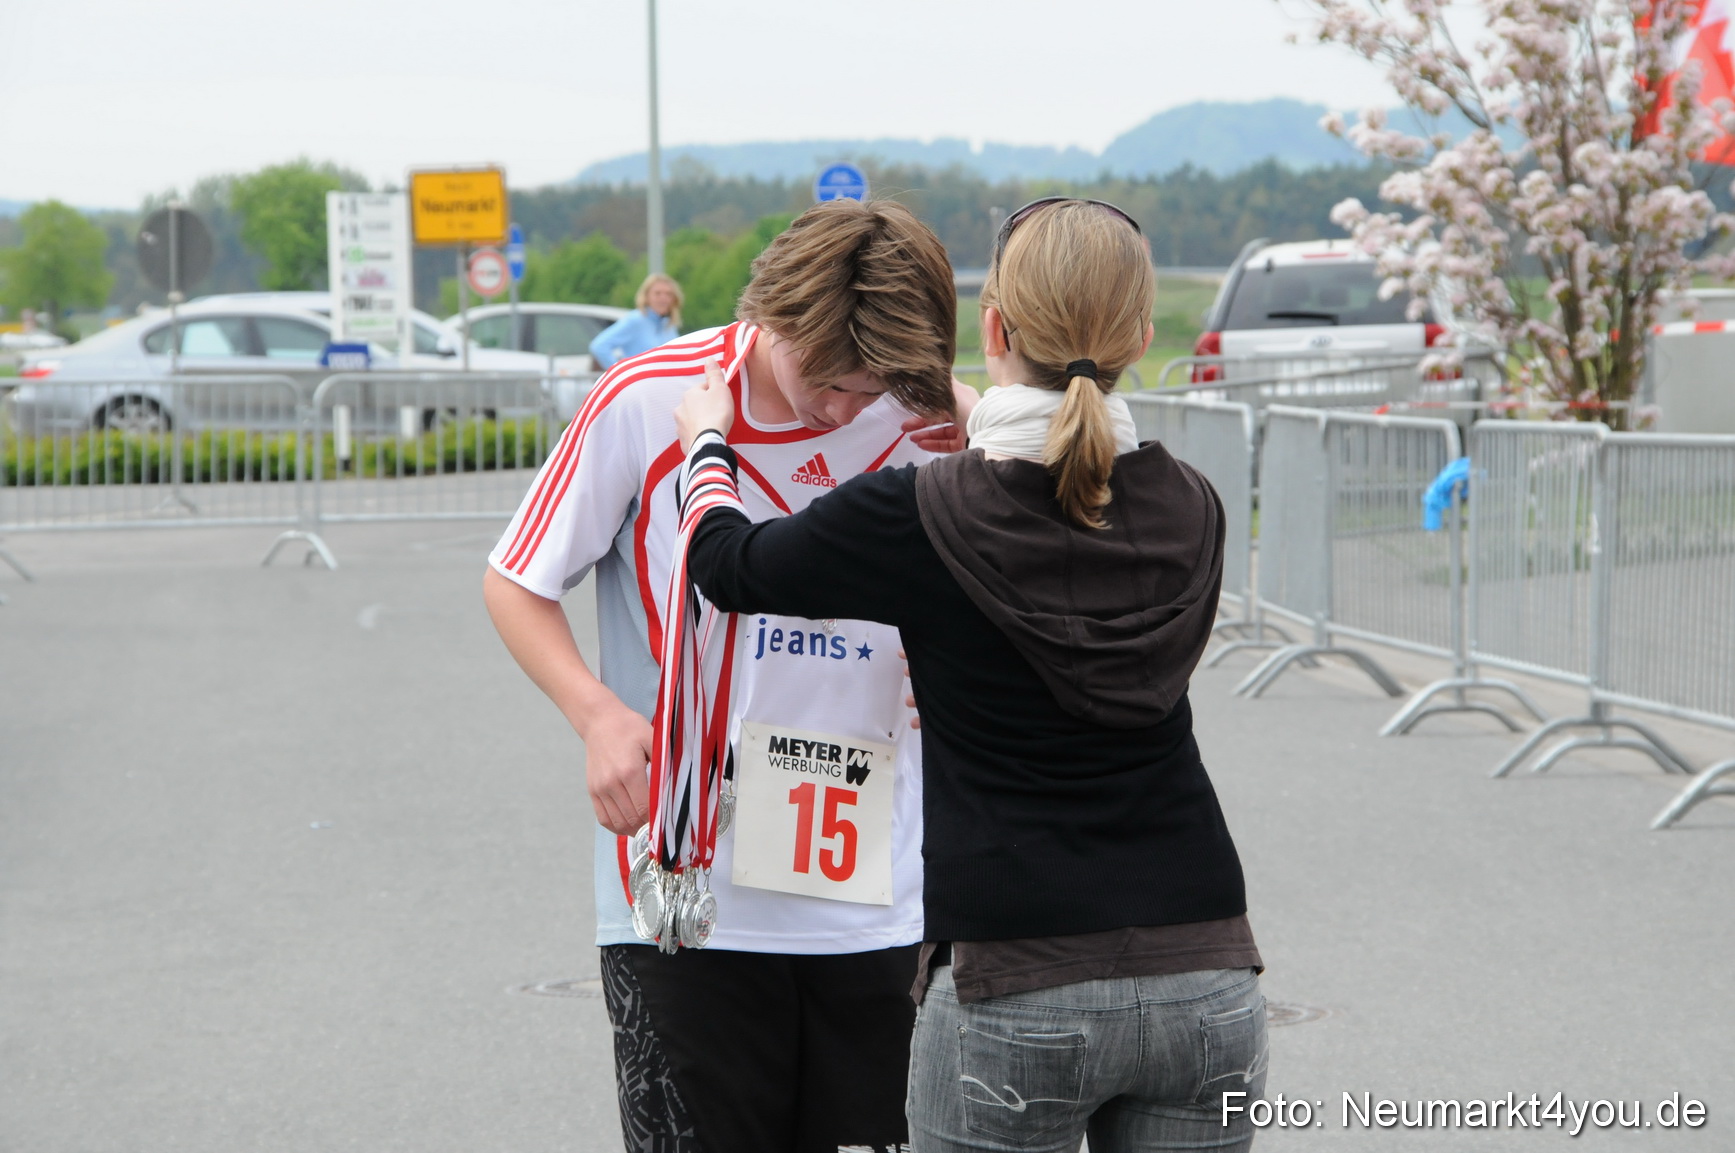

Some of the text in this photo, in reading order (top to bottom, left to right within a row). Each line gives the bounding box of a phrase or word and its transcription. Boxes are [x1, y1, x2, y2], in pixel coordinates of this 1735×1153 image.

[419, 196, 496, 214] Neumarkt
[791, 472, 837, 488] adidas
[754, 617, 847, 660] jeans
[768, 735, 842, 763] MEYER
[768, 755, 842, 778] WERBUNG
[788, 781, 858, 882] 15
